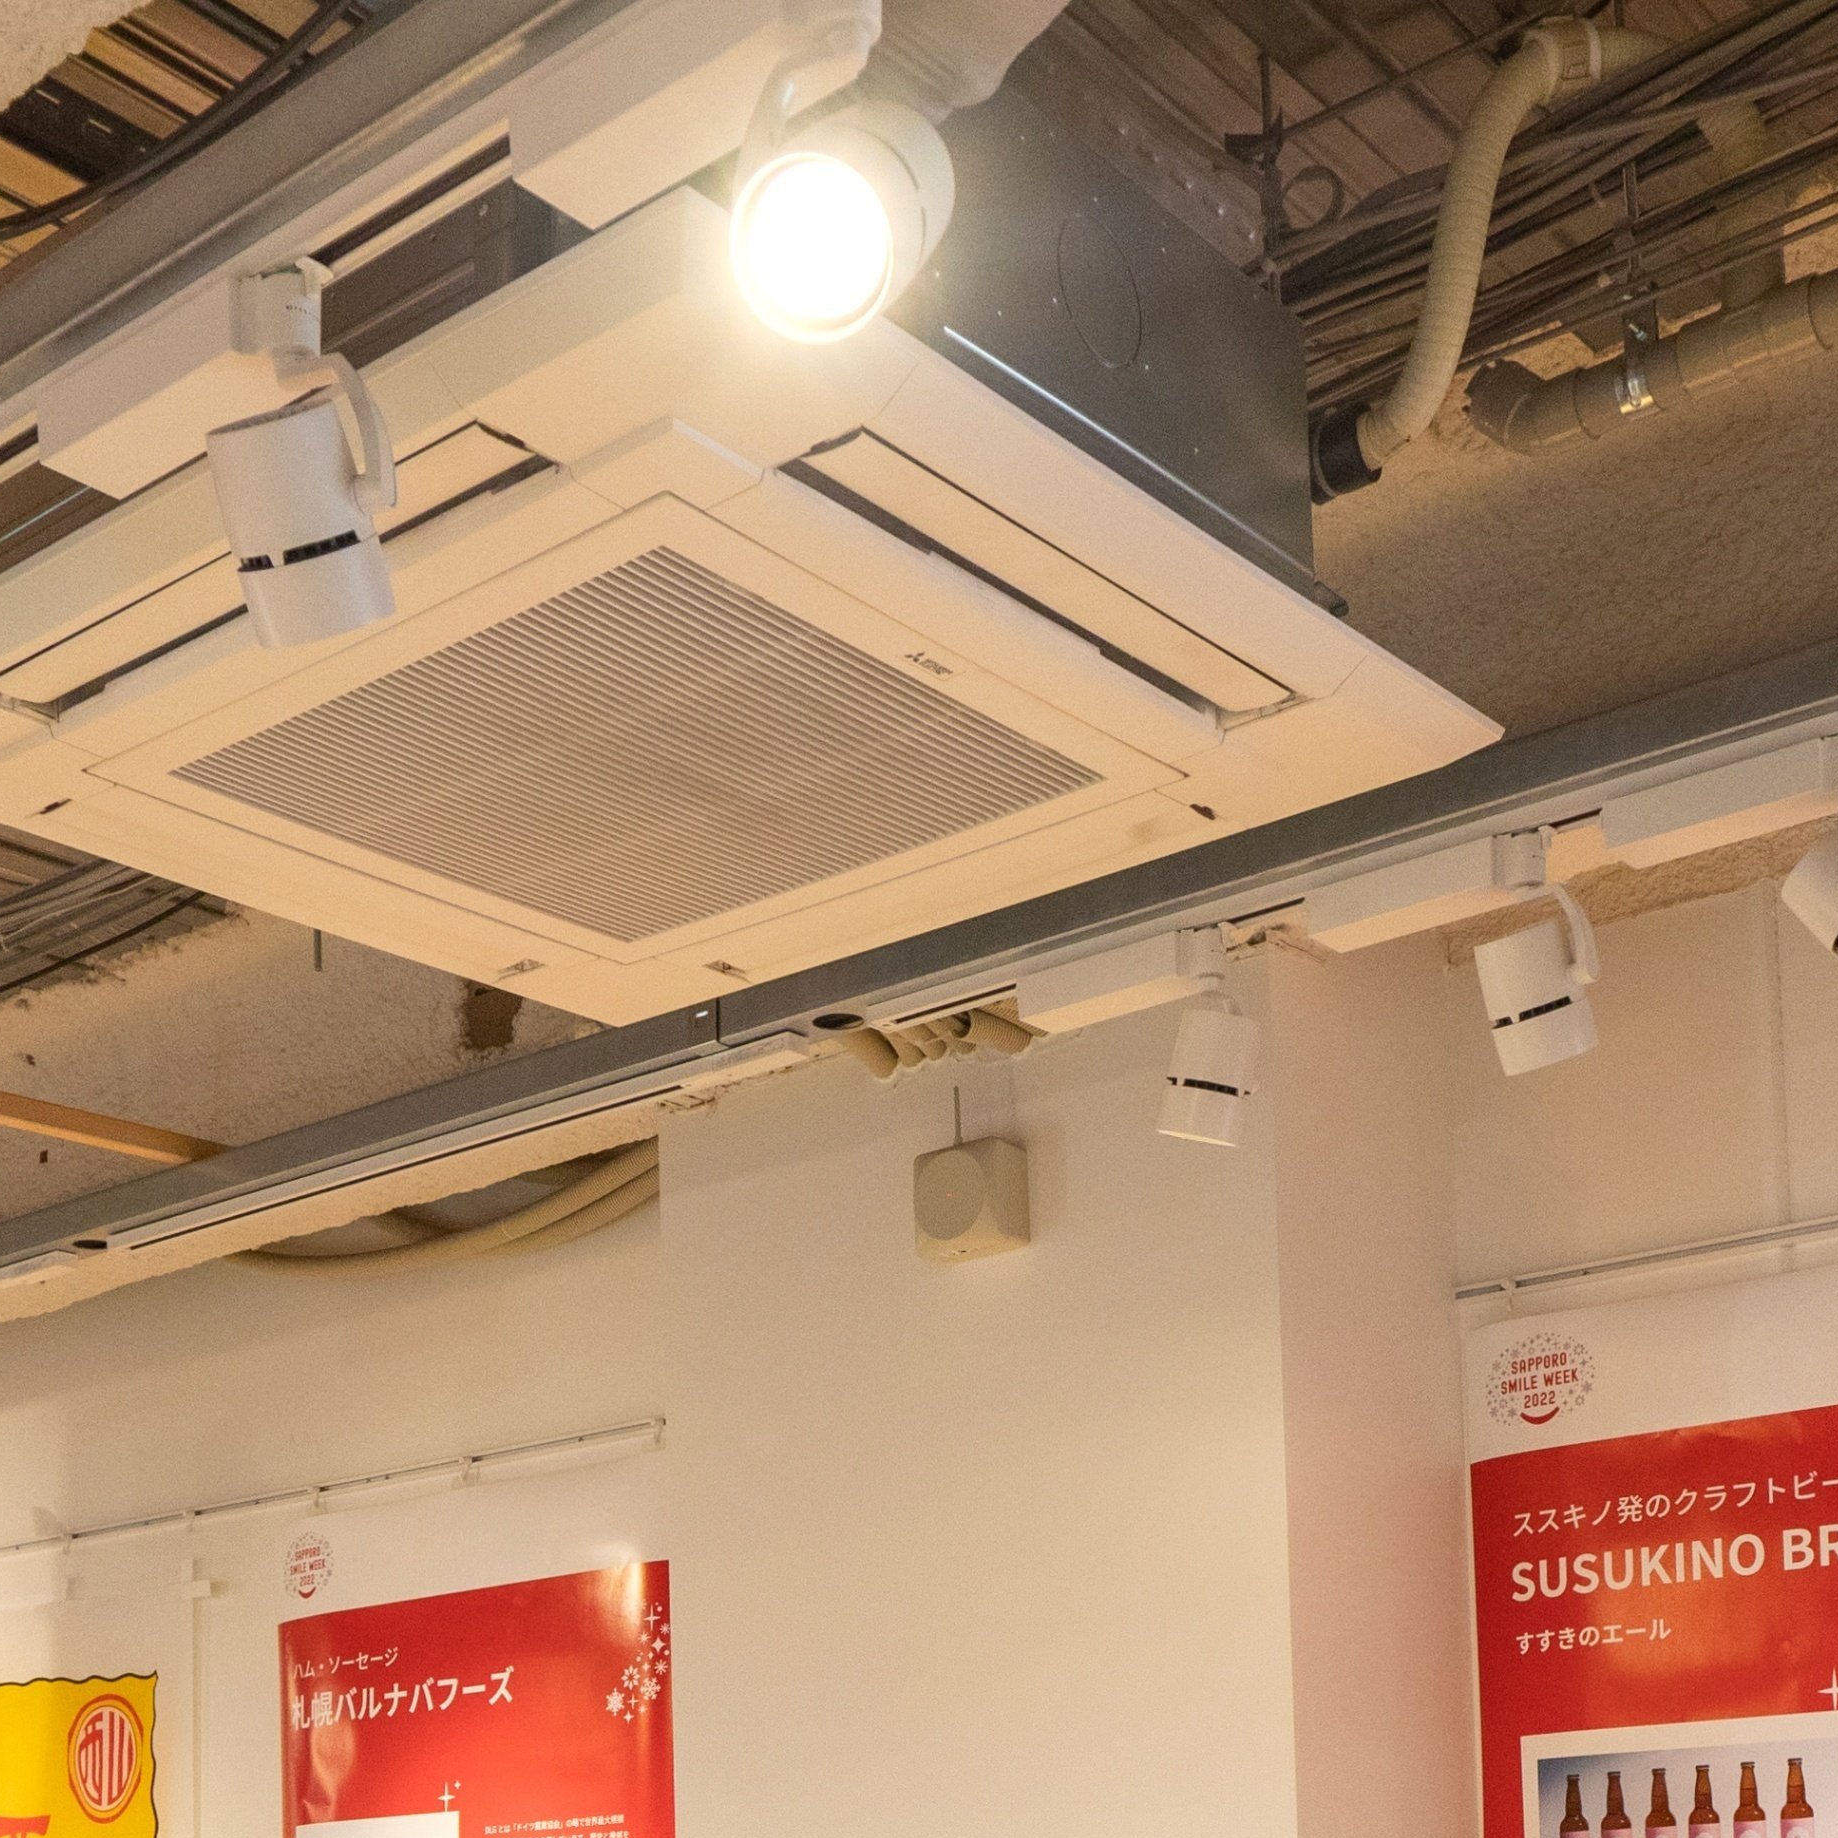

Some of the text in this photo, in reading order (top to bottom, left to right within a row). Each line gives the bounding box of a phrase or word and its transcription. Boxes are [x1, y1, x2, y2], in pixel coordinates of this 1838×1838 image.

[1511, 1352, 1567, 1374] SAPPORO
[1501, 1368, 1578, 1395] SMILE WEEK
[1524, 1391, 1556, 1408] 2022
[294, 1546, 321, 1561] SAPPORO
[289, 1559, 326, 1576] SMILE WEEK
[1511, 1531, 1765, 1604] SUSUKINO
[299, 1574, 315, 1586] 2022
[1515, 1616, 1672, 1657] すすきのエール
[293, 1646, 399, 1680] ハム・ソーセージ
[292, 1665, 515, 1731] 札幌バルナバフーズ
